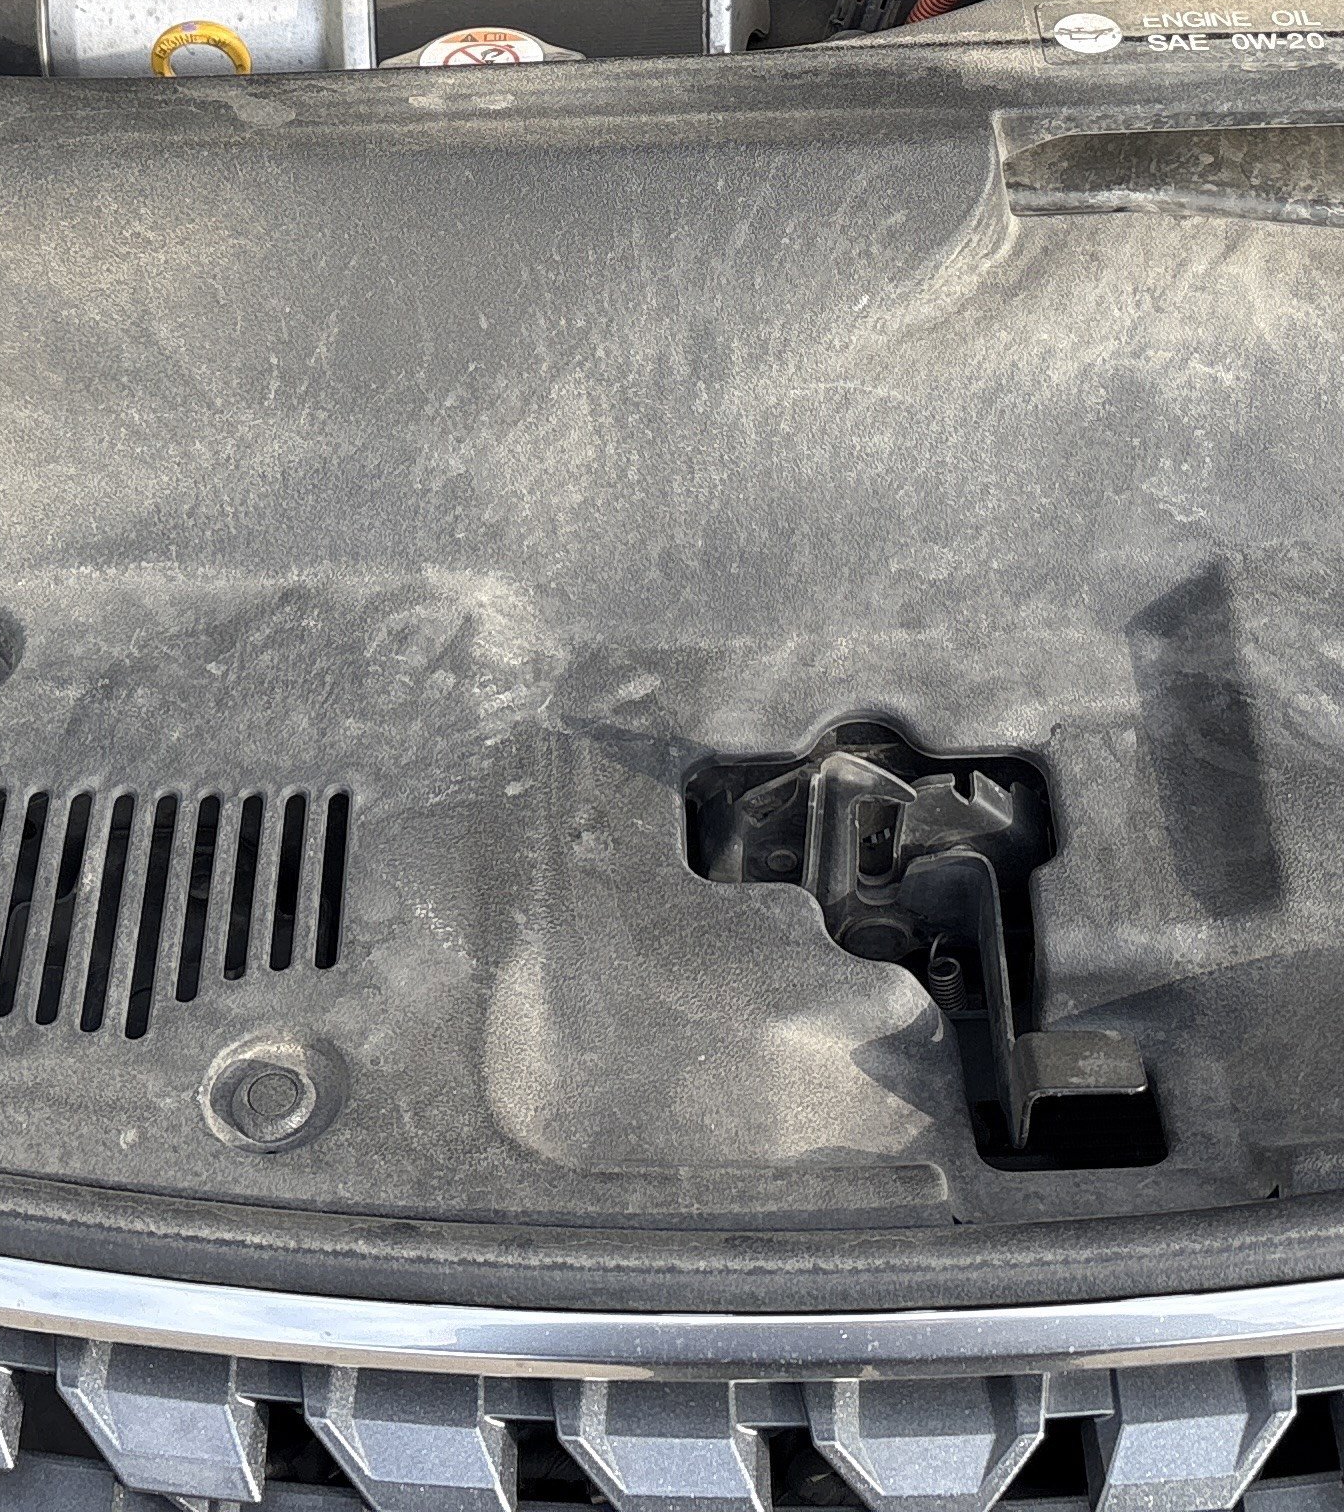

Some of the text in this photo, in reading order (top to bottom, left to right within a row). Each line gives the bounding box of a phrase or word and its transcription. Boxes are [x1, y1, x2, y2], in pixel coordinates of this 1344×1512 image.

[1142, 10, 1322, 28] ENGINE OIL
[1147, 32, 1326, 52] SAE 0W-20
